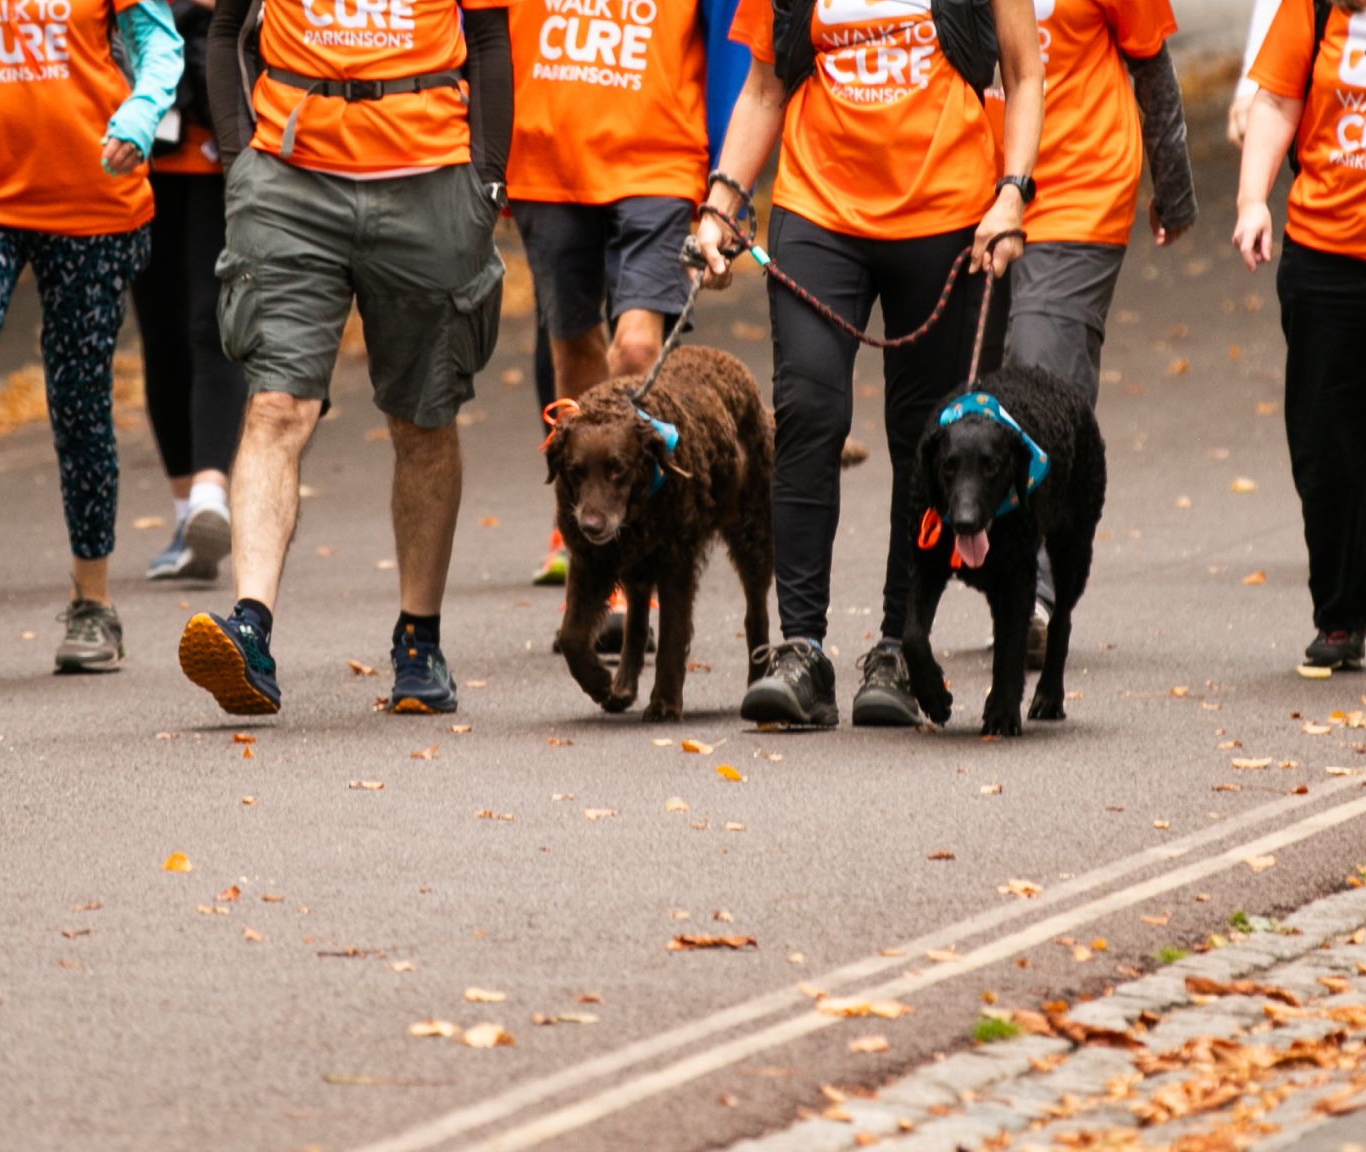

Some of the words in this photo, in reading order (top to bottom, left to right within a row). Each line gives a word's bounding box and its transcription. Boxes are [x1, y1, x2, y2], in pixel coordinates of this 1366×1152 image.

[304, 29, 414, 49] PARKINSON'S
[539, 15, 652, 71] CURE
[822, 23, 896, 48] WALK
[899, 20, 937, 44] TO
[532, 62, 643, 92] PARKINSON'S
[825, 45, 936, 85] CURE
